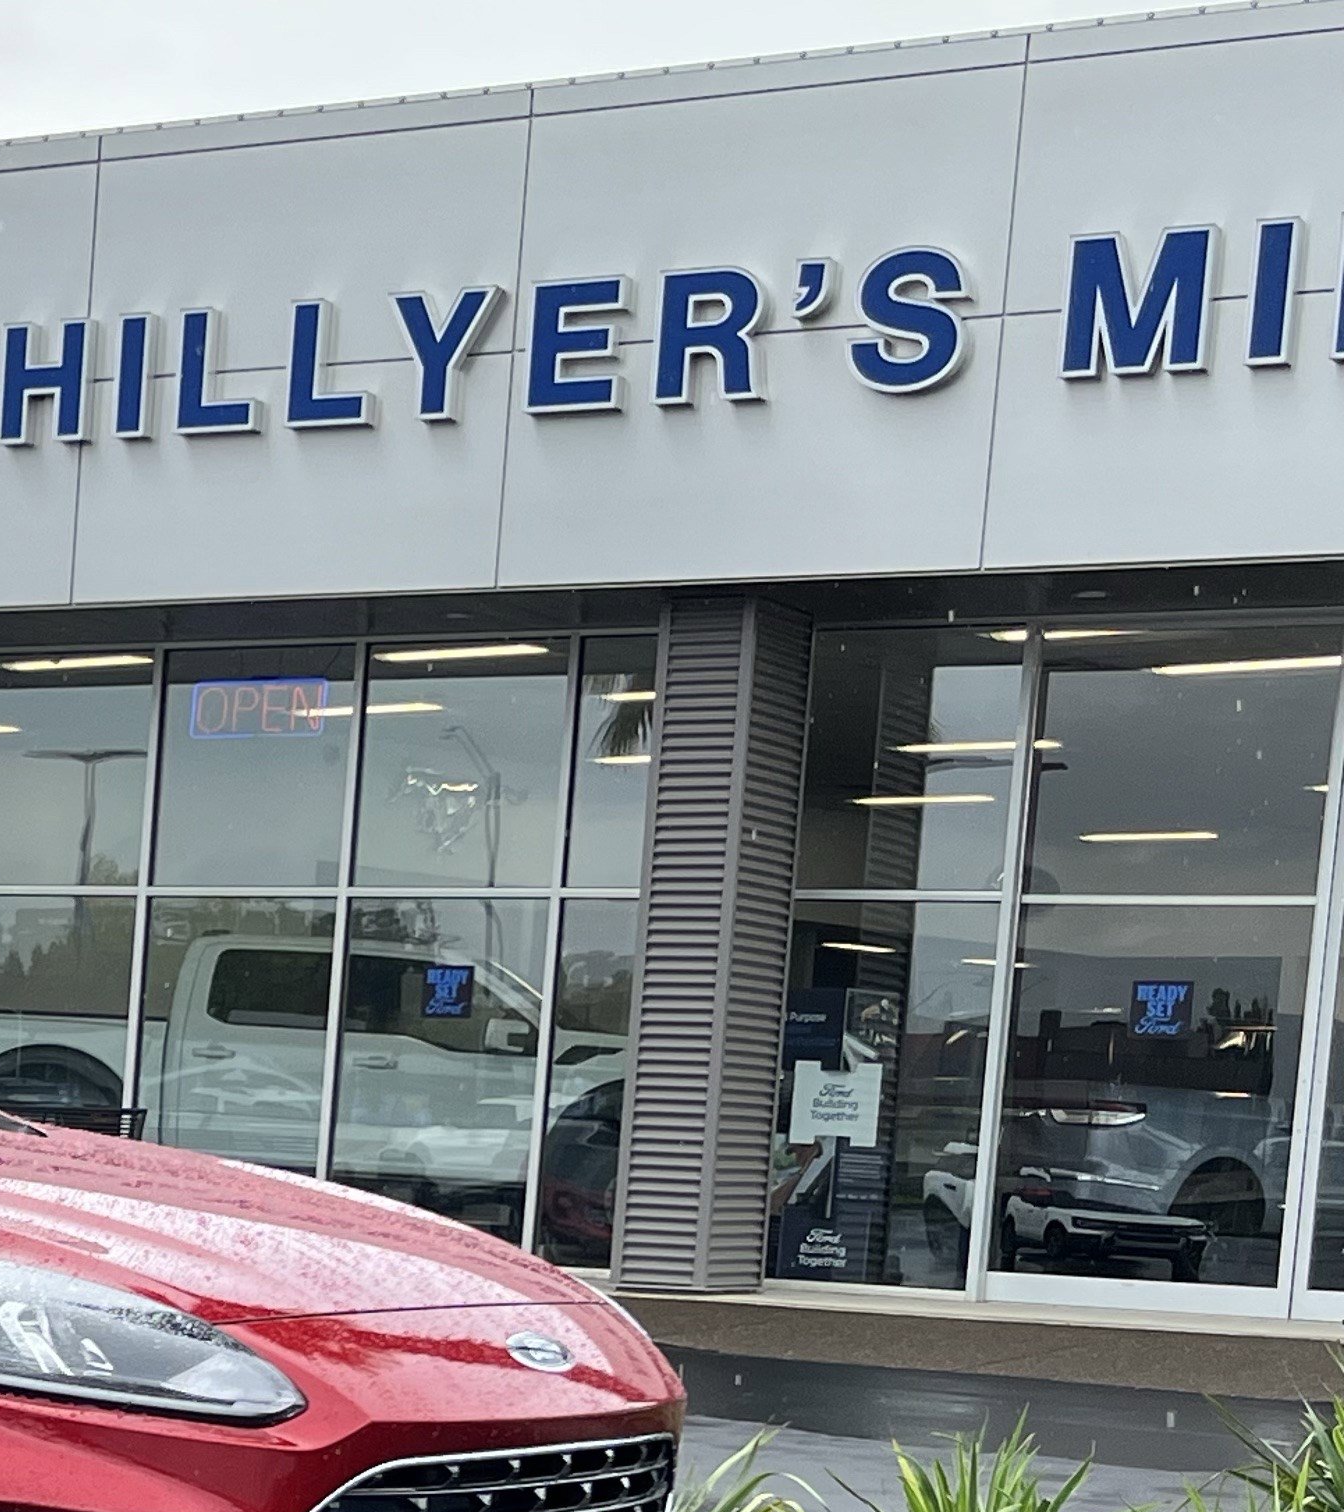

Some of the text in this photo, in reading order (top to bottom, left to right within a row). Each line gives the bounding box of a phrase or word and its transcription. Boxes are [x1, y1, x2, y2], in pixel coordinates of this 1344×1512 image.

[1057, 212, 1344, 381] MI
[197, 684, 323, 734] OPEN
[1137, 985, 1188, 1001] READY
[1146, 1000, 1172, 1017] SET
[1134, 1016, 1184, 1035] Ford
[818, 1083, 854, 1097] Ford
[812, 1098, 859, 1111] Building
[810, 1110, 859, 1122] Together
[806, 1228, 843, 1244] Ford
[797, 1254, 848, 1268] Together
